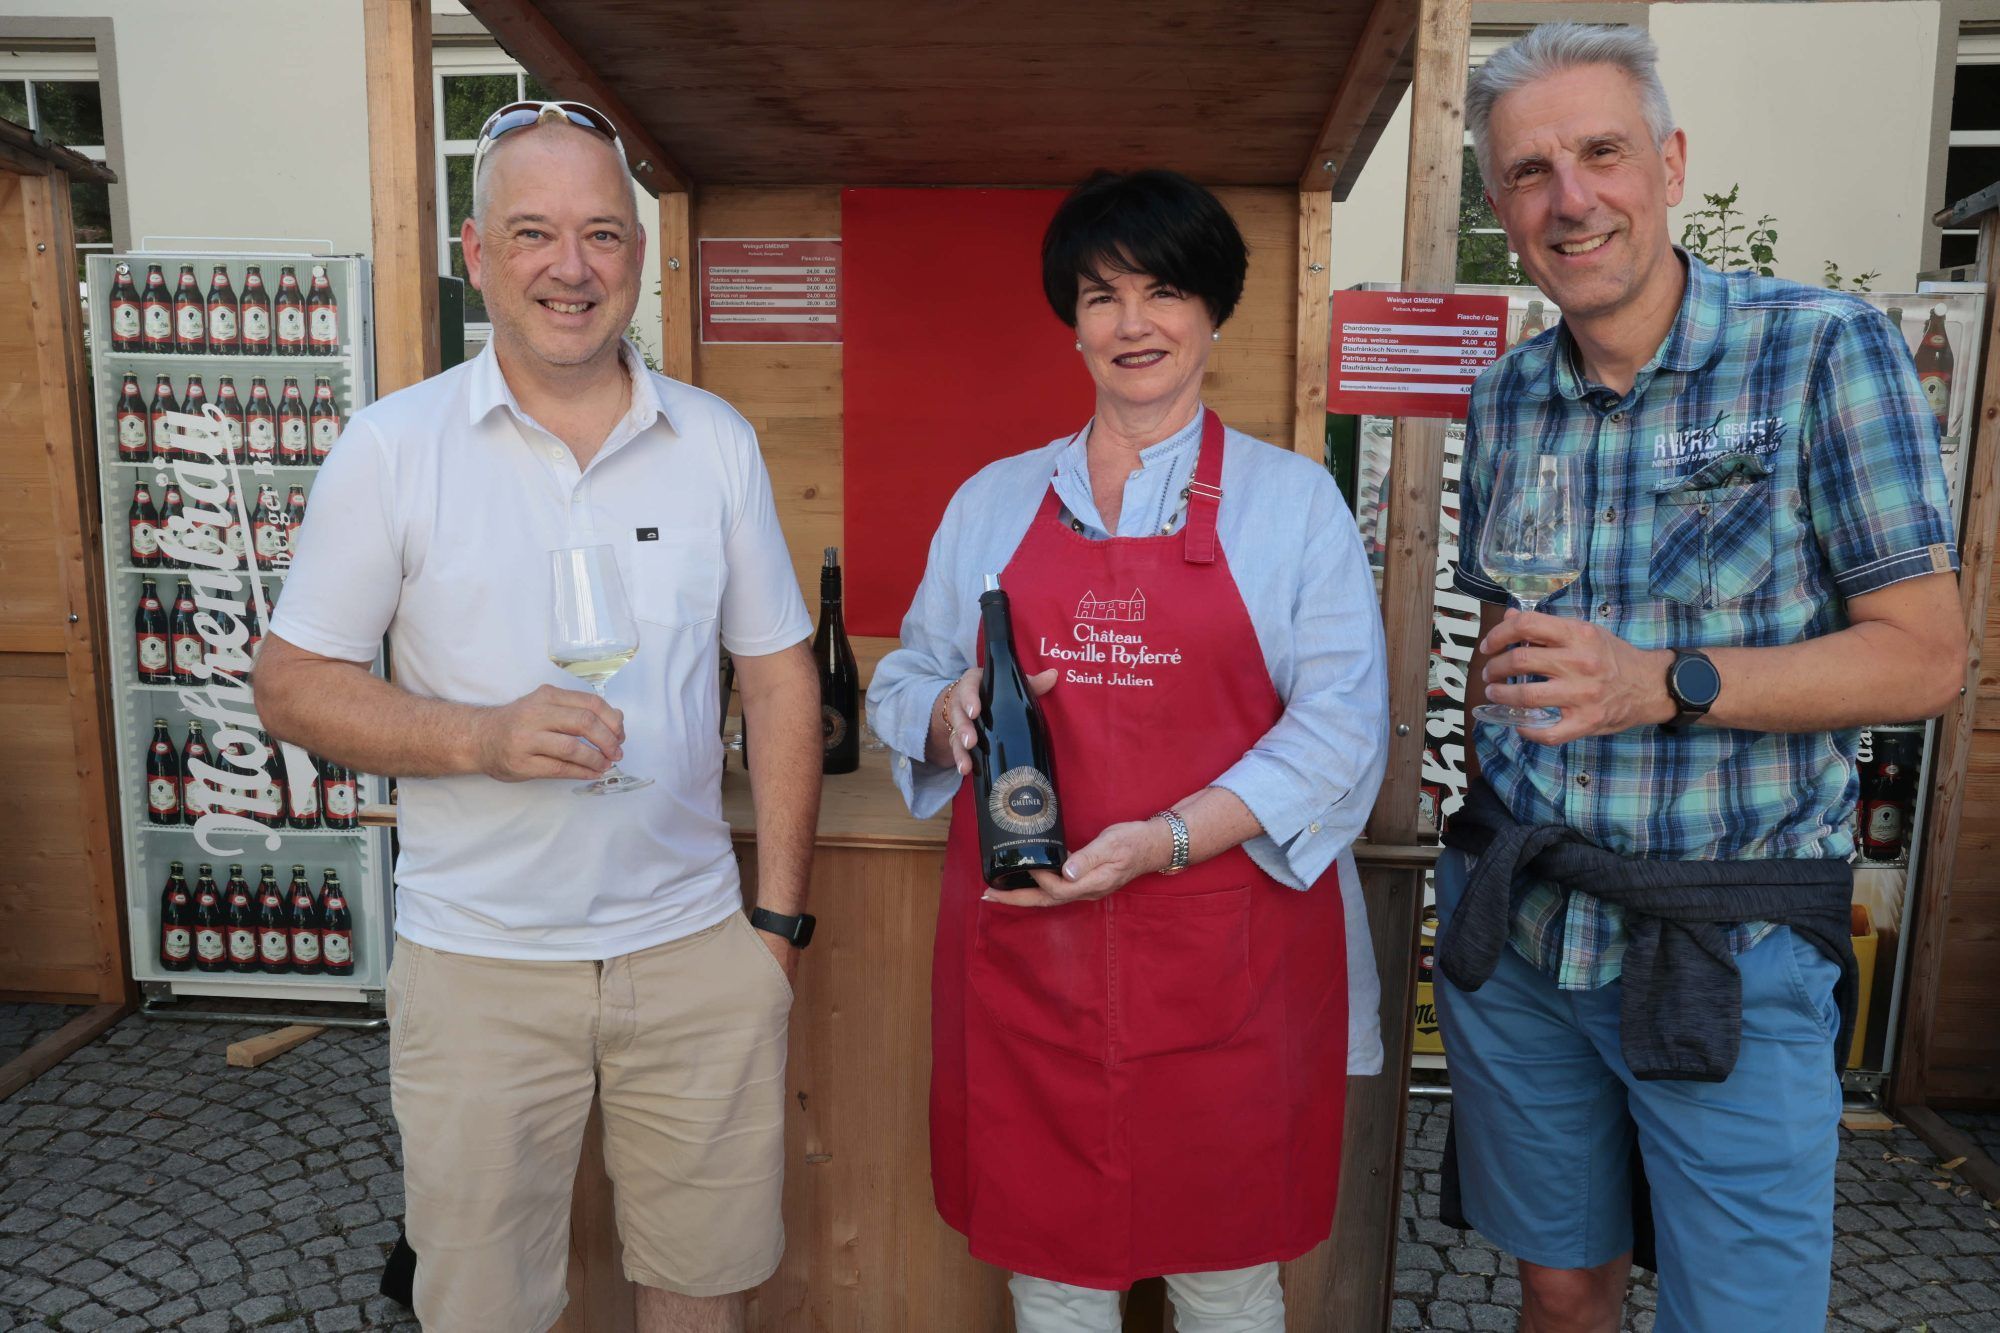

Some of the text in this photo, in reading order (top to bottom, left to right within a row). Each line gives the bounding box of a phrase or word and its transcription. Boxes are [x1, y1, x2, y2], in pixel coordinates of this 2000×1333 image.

[1073, 623, 1142, 644] Château
[1040, 637, 1182, 668] Léoville Poyferré
[1066, 670, 1154, 686] Saint Julien
